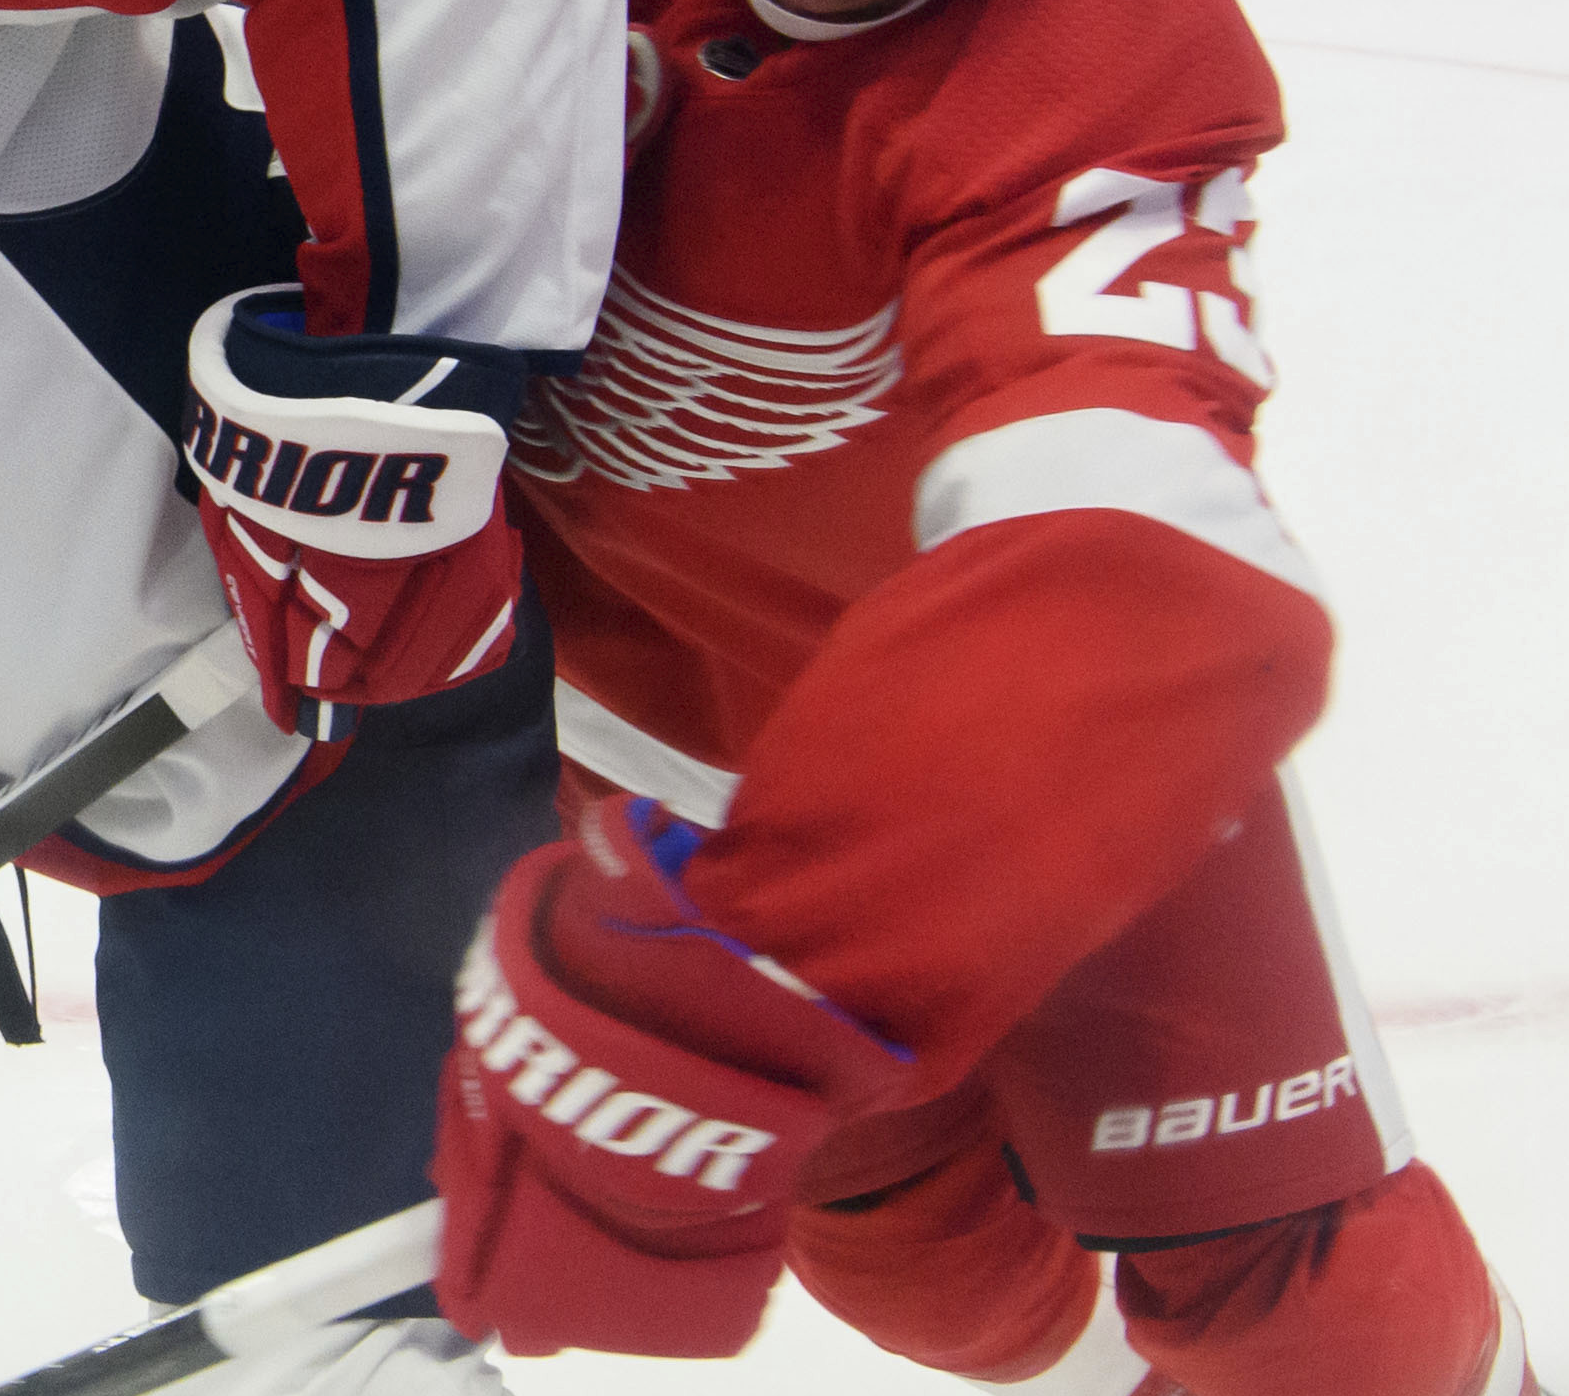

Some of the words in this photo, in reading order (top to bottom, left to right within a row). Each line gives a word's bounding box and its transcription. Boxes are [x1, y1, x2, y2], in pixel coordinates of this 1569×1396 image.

[1034, 166, 1279, 390] 23
[185, 402, 449, 524] RRIOR
[454, 923, 778, 1193] RRIOR
